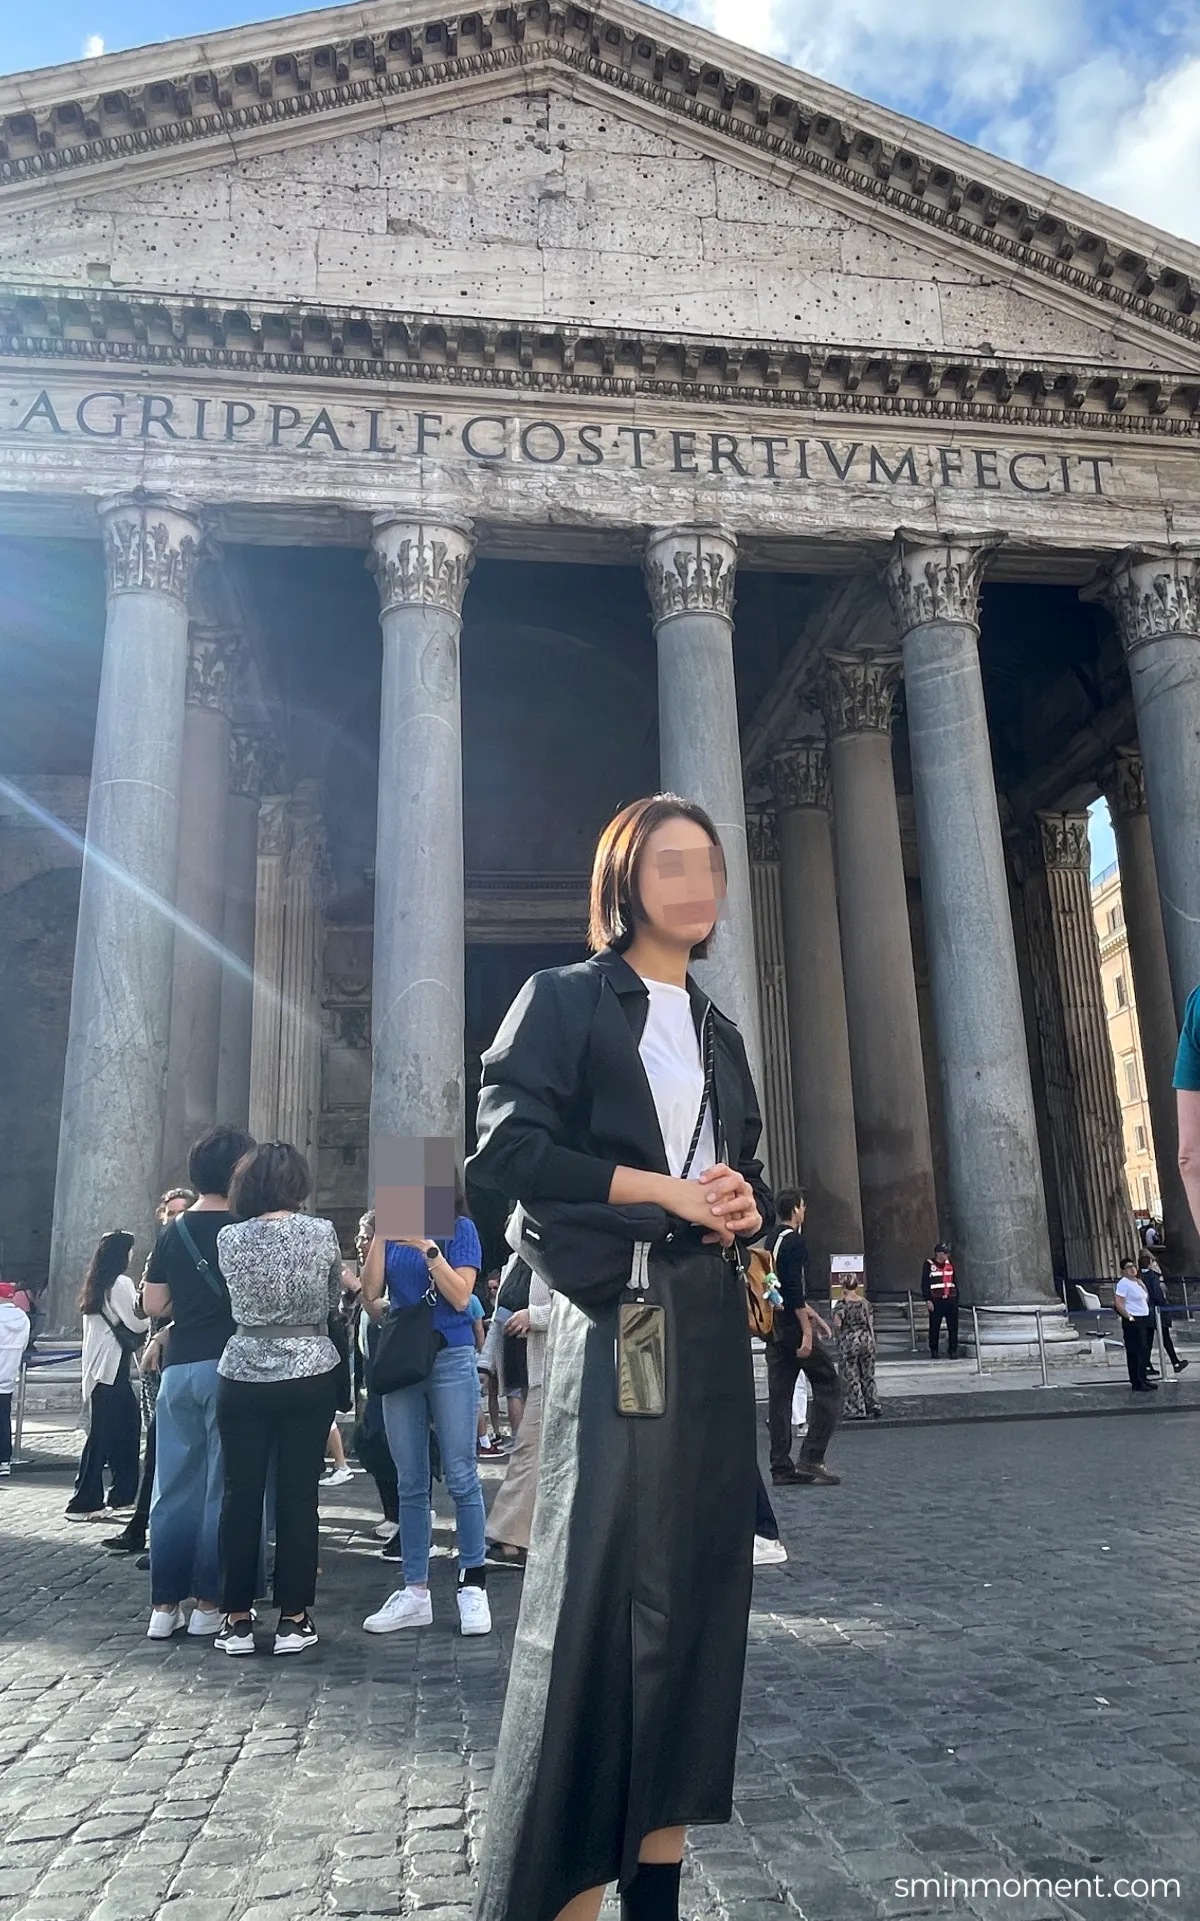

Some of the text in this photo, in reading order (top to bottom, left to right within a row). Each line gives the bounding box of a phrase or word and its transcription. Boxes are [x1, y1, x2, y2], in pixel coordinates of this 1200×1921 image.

[15, 389, 349, 451] AGRIPPA
[461, 416, 605, 466] COS
[617, 426, 920, 487] TERTIVM
[935, 446, 1114, 495] FECIT
